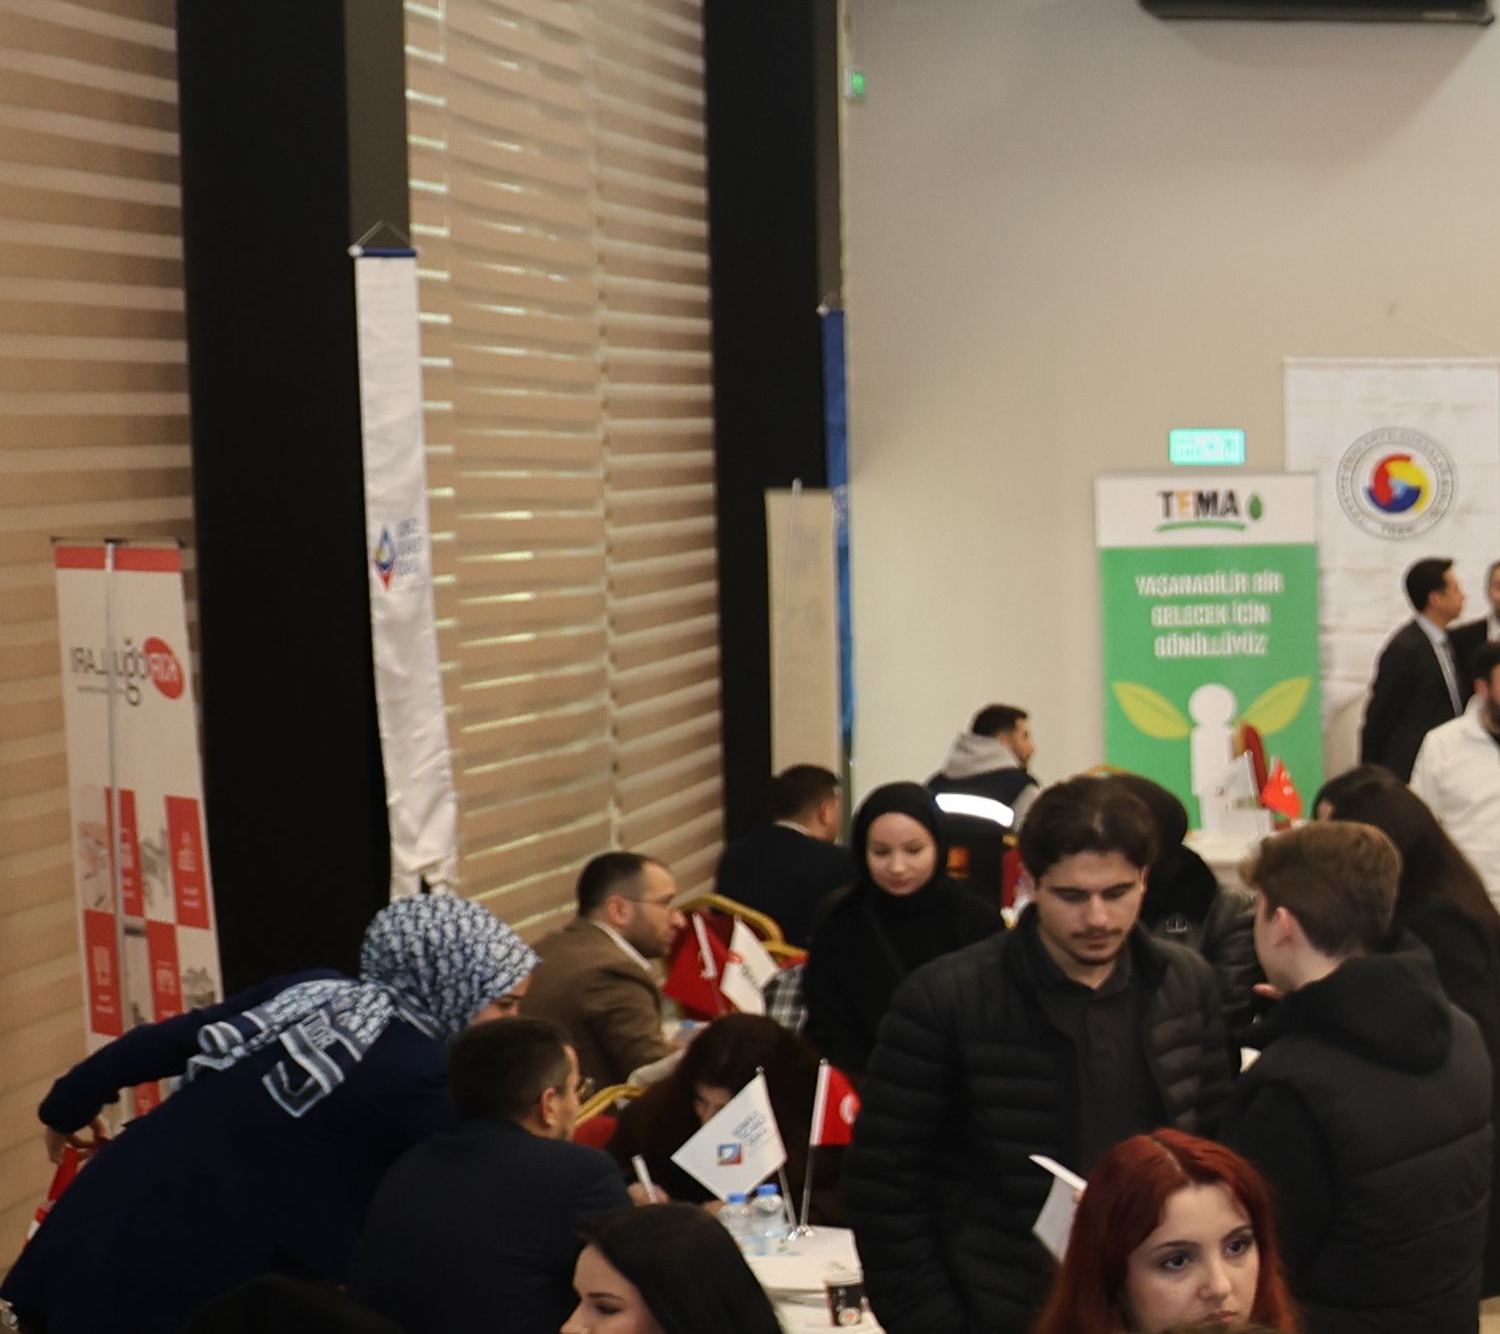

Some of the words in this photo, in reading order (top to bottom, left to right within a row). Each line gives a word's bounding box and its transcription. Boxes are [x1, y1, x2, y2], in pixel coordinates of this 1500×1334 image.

[1158, 489, 1239, 519] TEMA
[1135, 569, 1247, 597] YAŞANABİLİR
[1252, 568, 1284, 593] BİR
[1151, 603, 1228, 627] GELECEK
[1232, 600, 1270, 627] İÇİN
[1154, 631, 1268, 658] GÖNÜLLÜYÜZ
